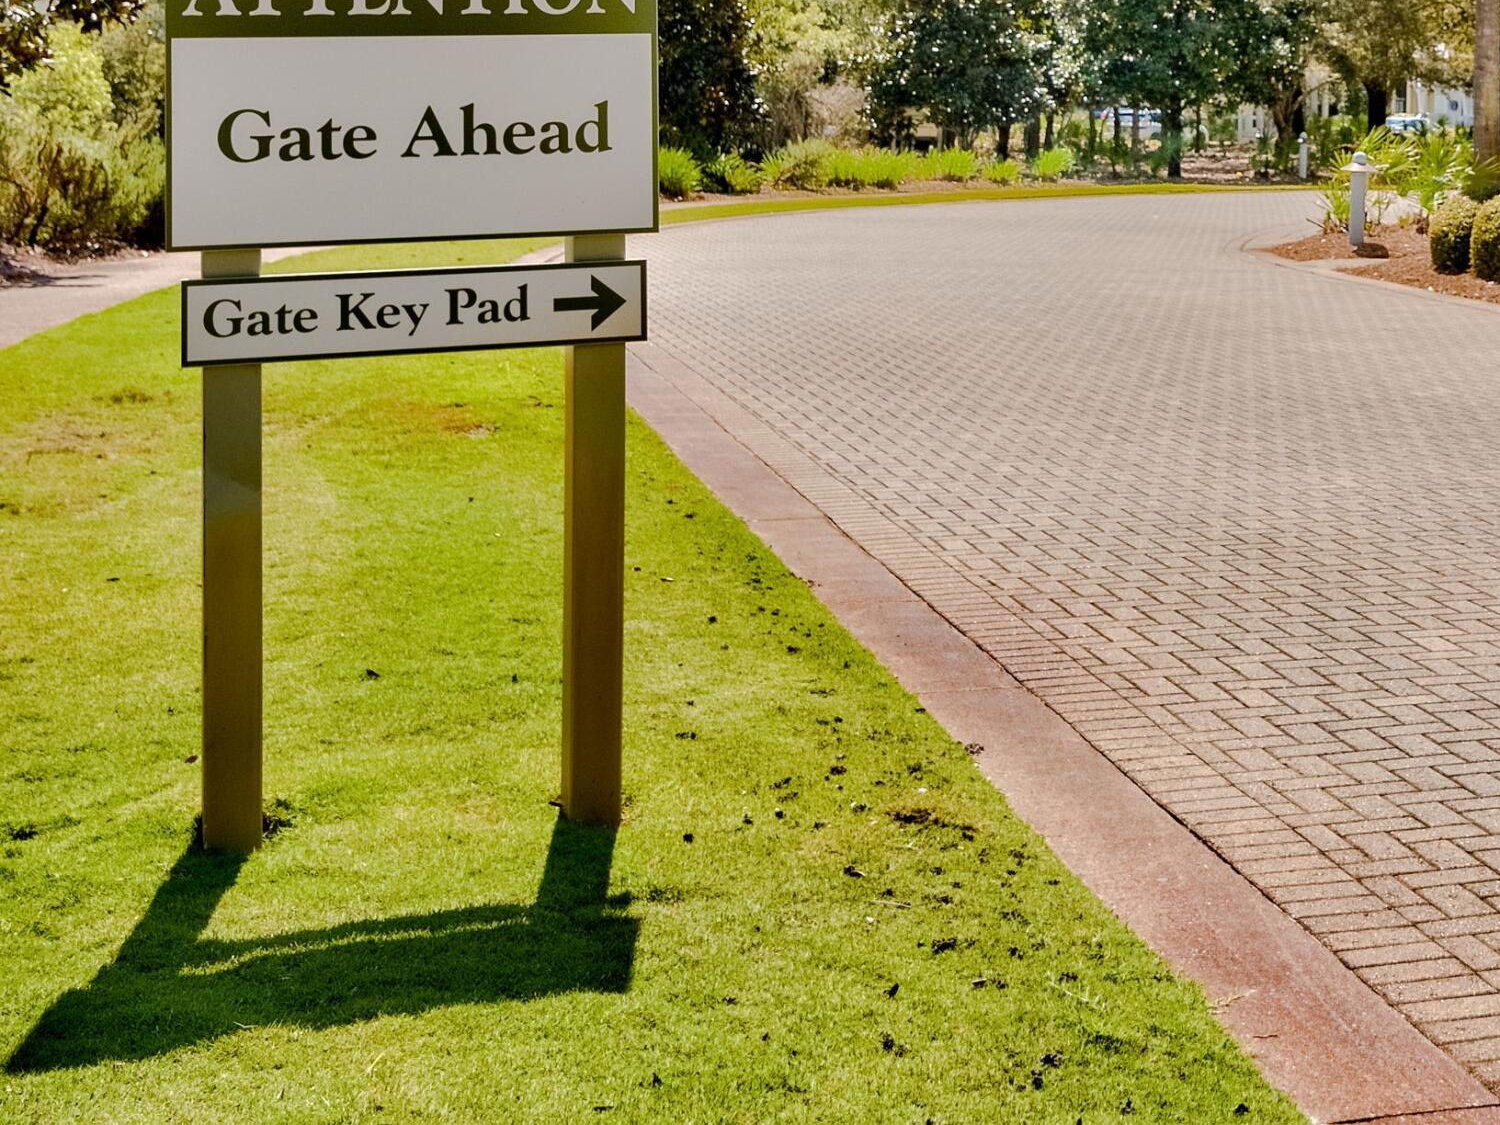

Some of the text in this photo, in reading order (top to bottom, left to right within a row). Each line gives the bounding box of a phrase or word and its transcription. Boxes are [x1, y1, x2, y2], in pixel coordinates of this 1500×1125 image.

[217, 100, 612, 163] Gate Ahead
[203, 283, 531, 339] Gate Key Pad
